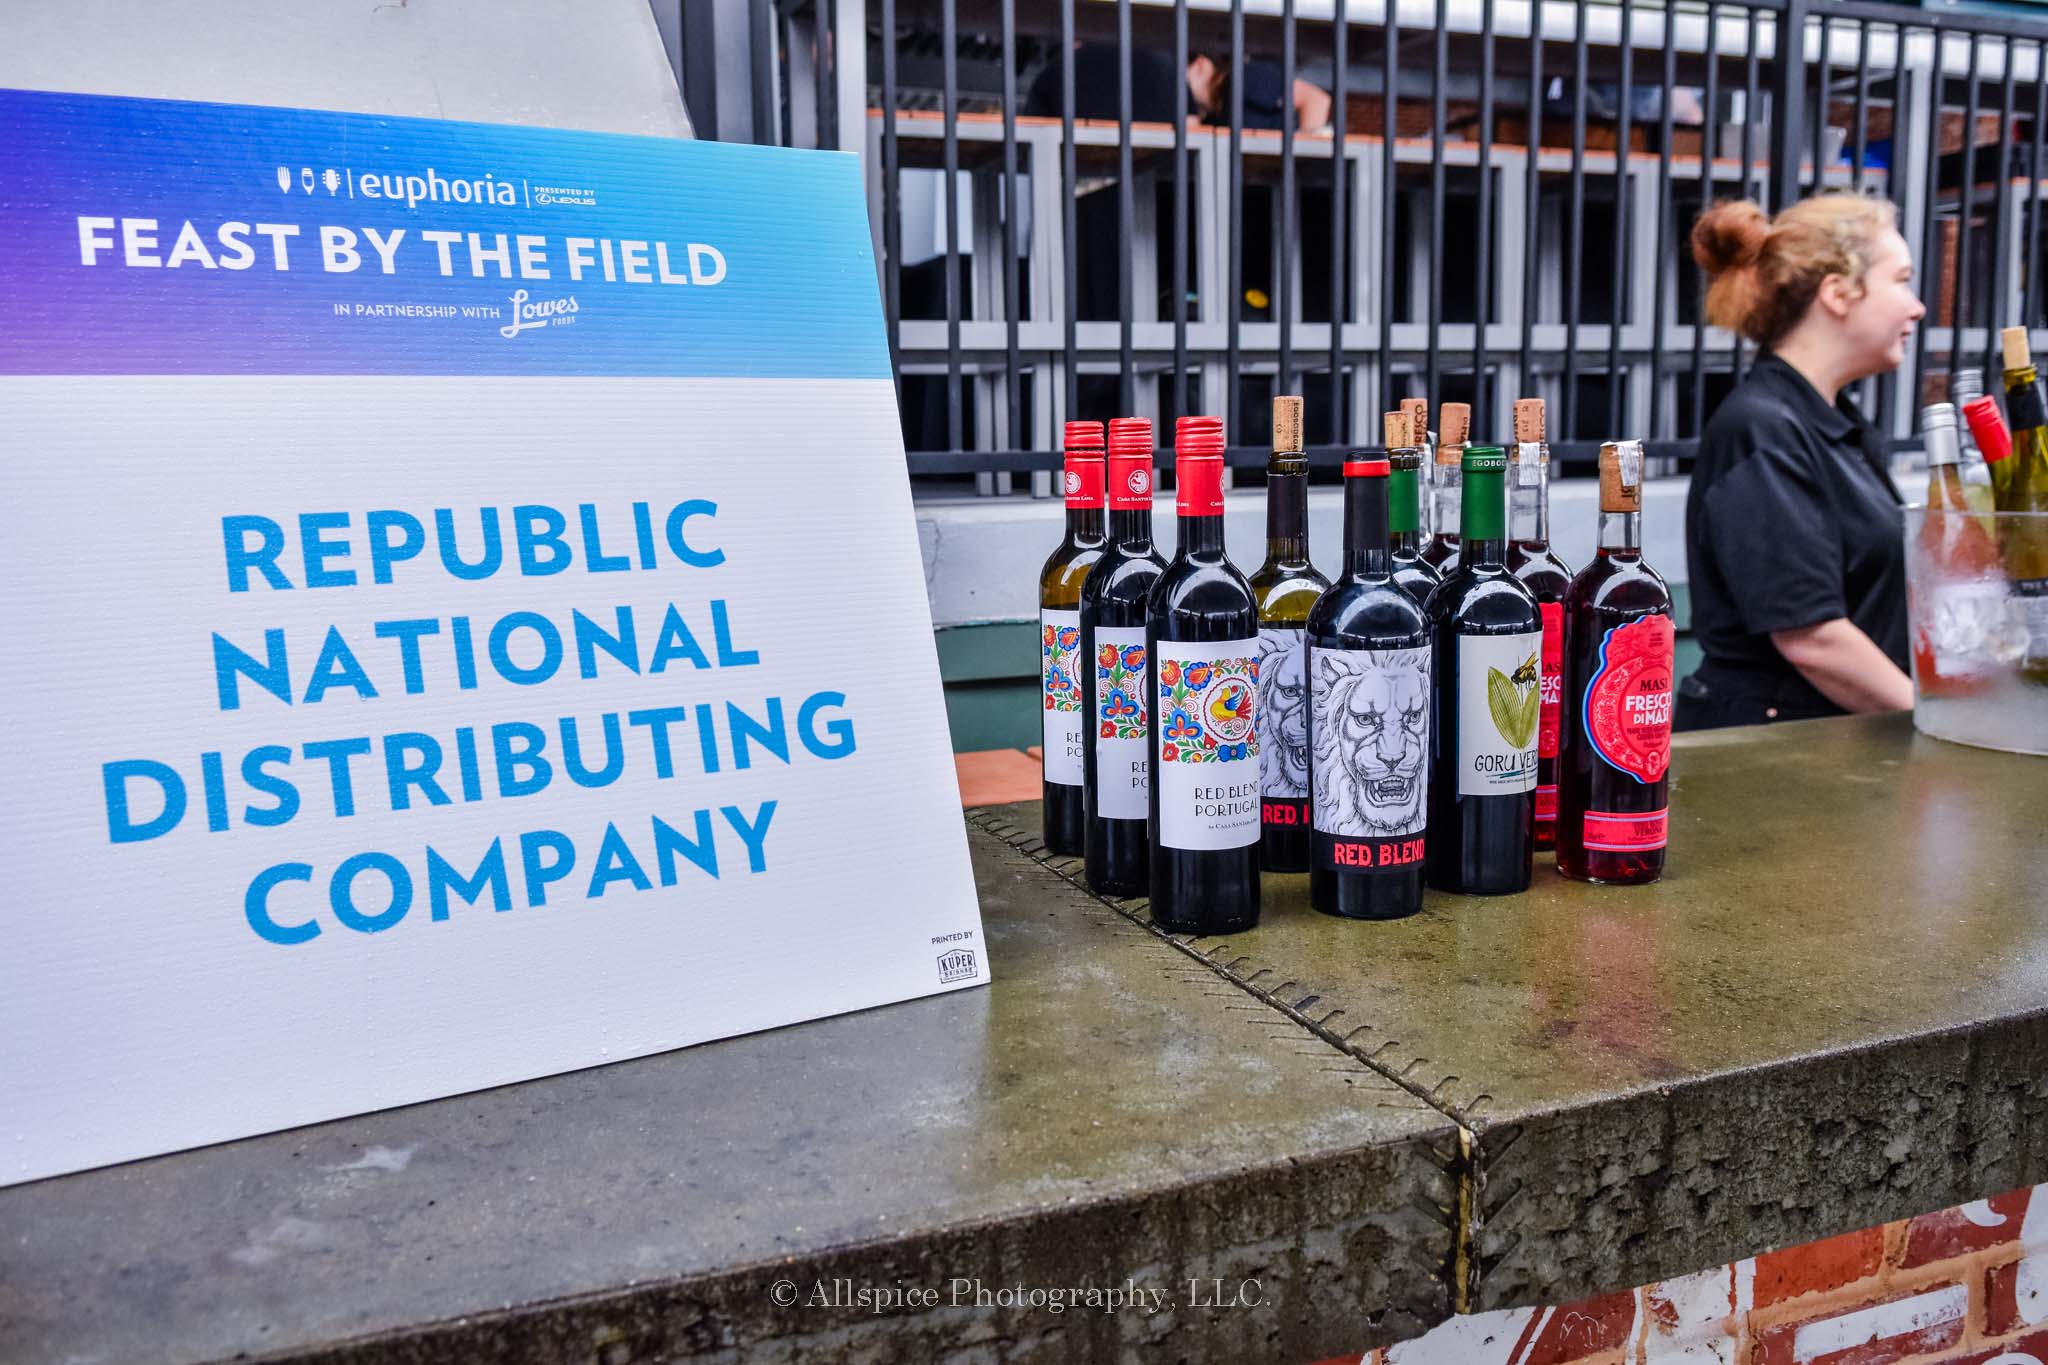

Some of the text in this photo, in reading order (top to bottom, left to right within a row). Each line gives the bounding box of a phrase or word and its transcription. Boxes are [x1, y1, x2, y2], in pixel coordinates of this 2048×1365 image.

[359, 168, 516, 208] euphoria
[534, 186, 595, 197] PRESENTED BY
[551, 196, 597, 206] LEXUS
[77, 216, 727, 287] FEAST BY THE FIELD
[334, 288, 580, 339] IN PARTNERSHIP WITH Lowes
[1414, 403, 1424, 447] RESCO
[221, 499, 727, 592] REPUBLIC
[211, 599, 760, 711] NATIONAL
[1540, 674, 1562, 690] ESC
[1640, 677, 1668, 692] MASI
[1540, 689, 1561, 704] MA
[1625, 691, 1672, 712] FRESCO
[1633, 707, 1669, 725] DI MASI
[1066, 732, 1082, 744] RE
[102, 690, 857, 843] DISTRIBUTING
[1131, 761, 1148, 773] RE
[1474, 749, 1537, 772] GORU VER
[1194, 780, 1258, 800] RED BLEND
[1195, 797, 1258, 817] PORTUGAL
[1333, 838, 1425, 868] RED BLEND
[244, 800, 778, 945] COMPANY
[931, 931, 974, 945] PRINTED BY
[941, 953, 973, 972] KUPER
